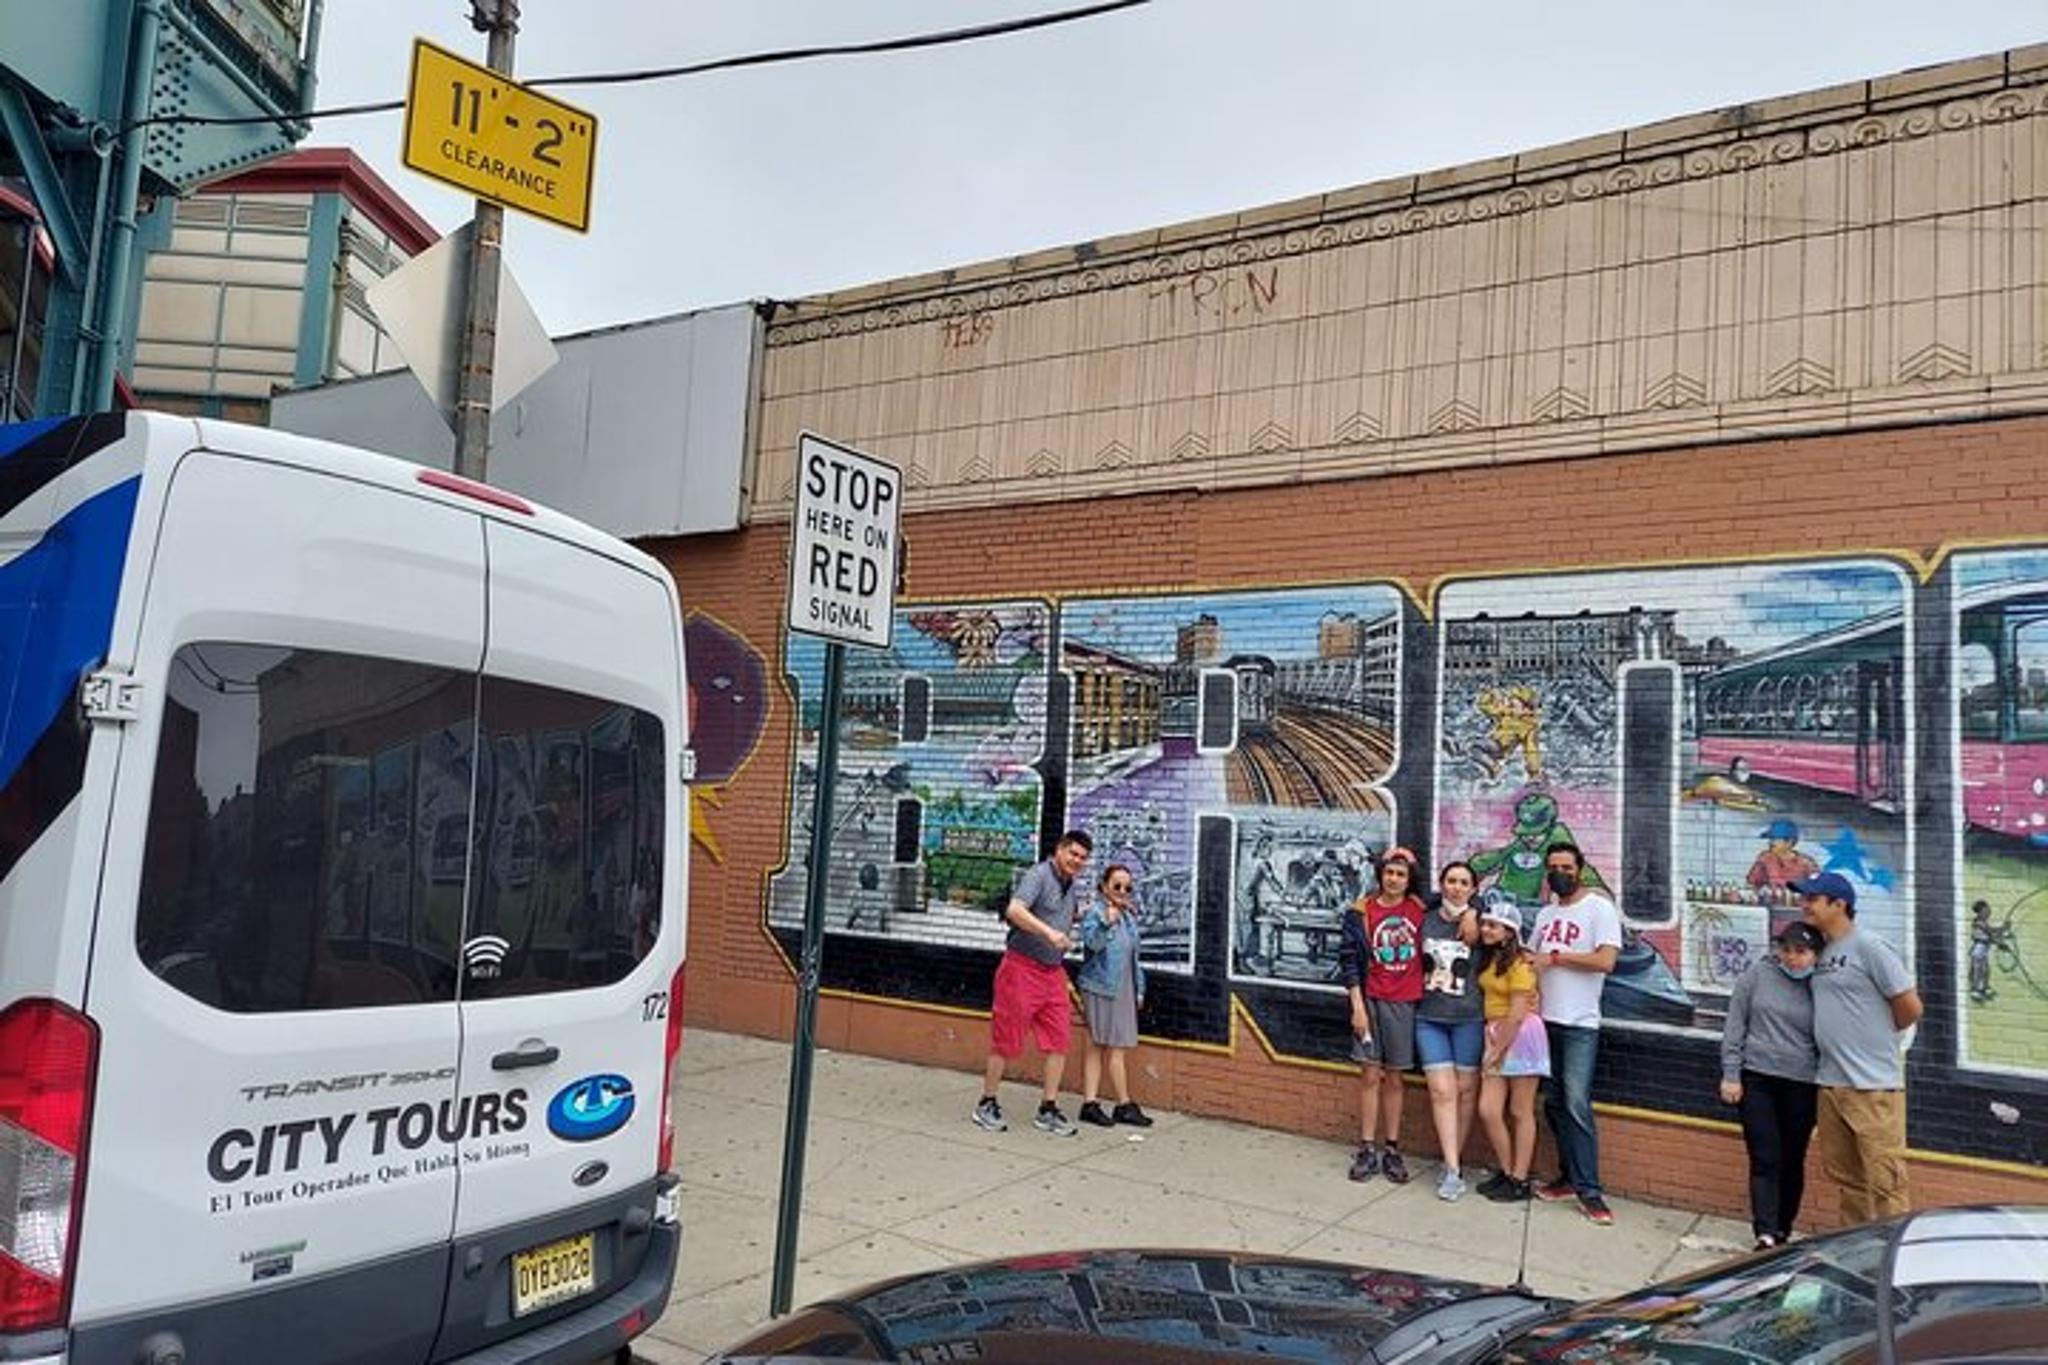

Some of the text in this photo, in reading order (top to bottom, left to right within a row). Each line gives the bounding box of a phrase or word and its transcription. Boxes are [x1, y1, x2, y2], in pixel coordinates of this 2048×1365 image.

[440, 139, 558, 200] CLEARANCE
[807, 454, 893, 516] STOP
[806, 508, 889, 550] HERE ON
[810, 543, 878, 598] RED
[810, 597, 873, 631] SIGNAL
[241, 1073, 388, 1101] TRANSIT
[207, 1087, 528, 1183] CITY TOURS
[210, 1194, 231, 1213] El
[242, 1189, 283, 1207] Tour
